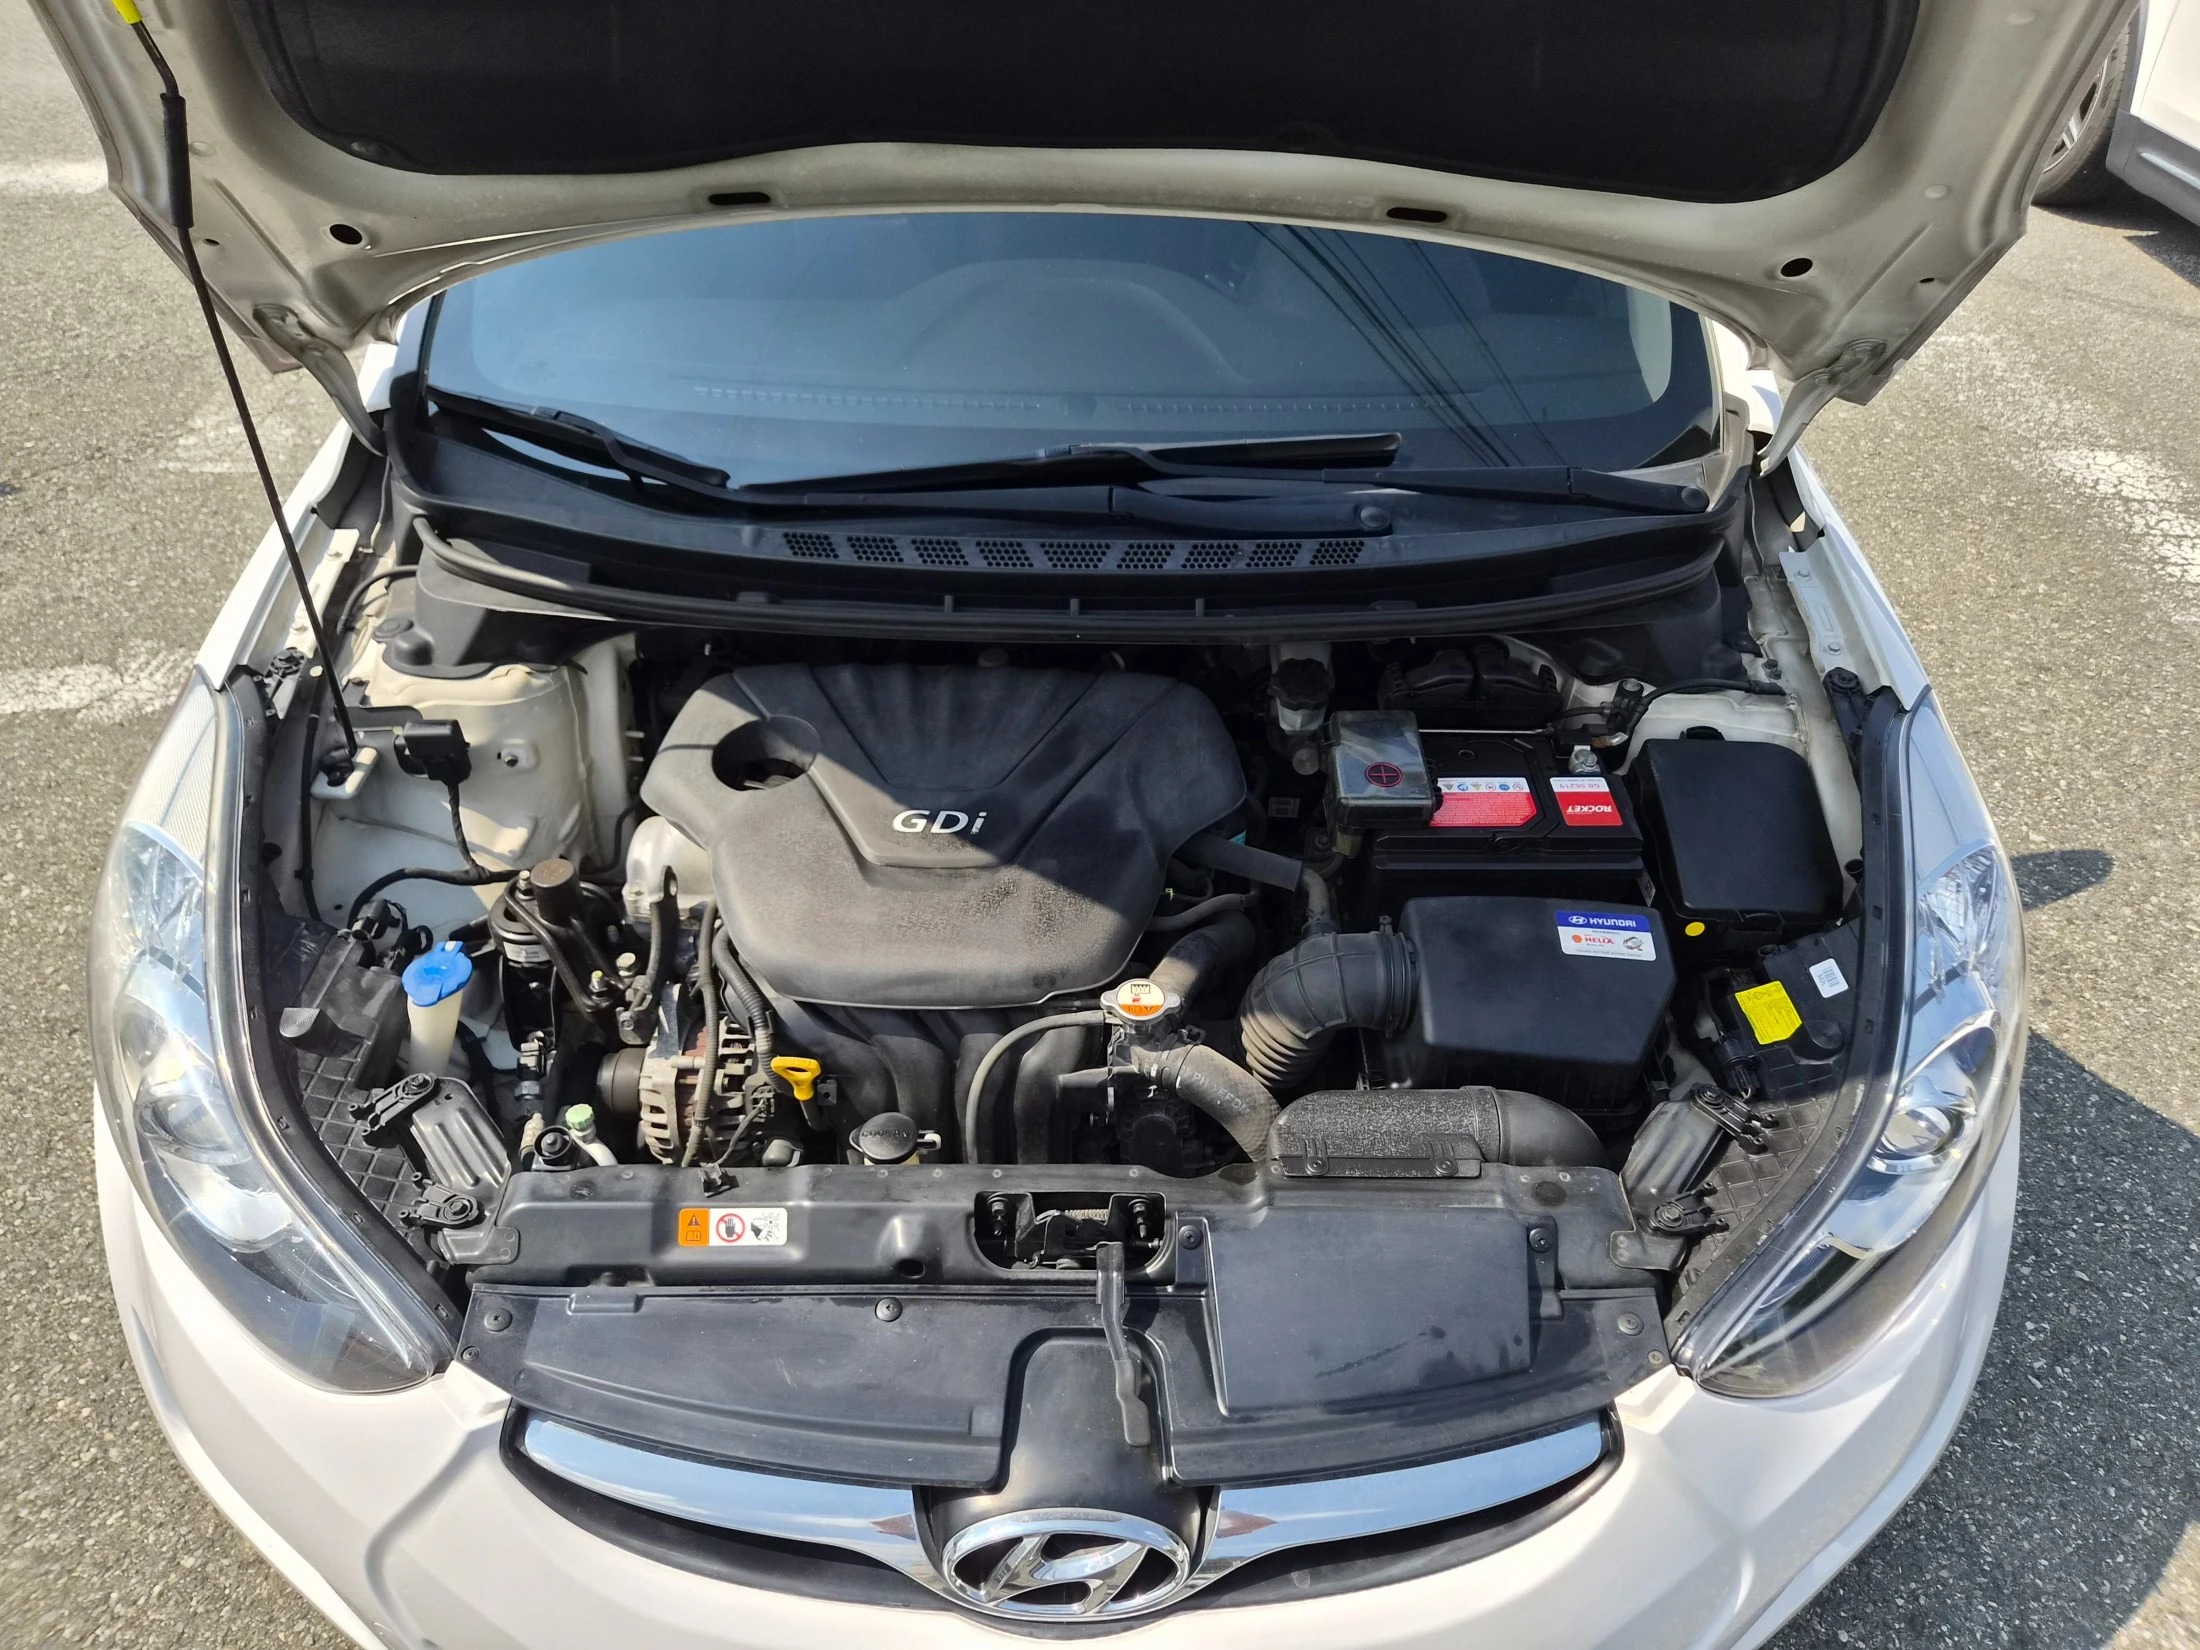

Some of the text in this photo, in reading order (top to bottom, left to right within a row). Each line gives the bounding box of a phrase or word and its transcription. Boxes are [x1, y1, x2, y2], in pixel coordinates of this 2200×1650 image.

[892, 809, 988, 834] GDi
[1589, 917, 1636, 927] HYUNDAI
[1585, 936, 1615, 944] HELIX
